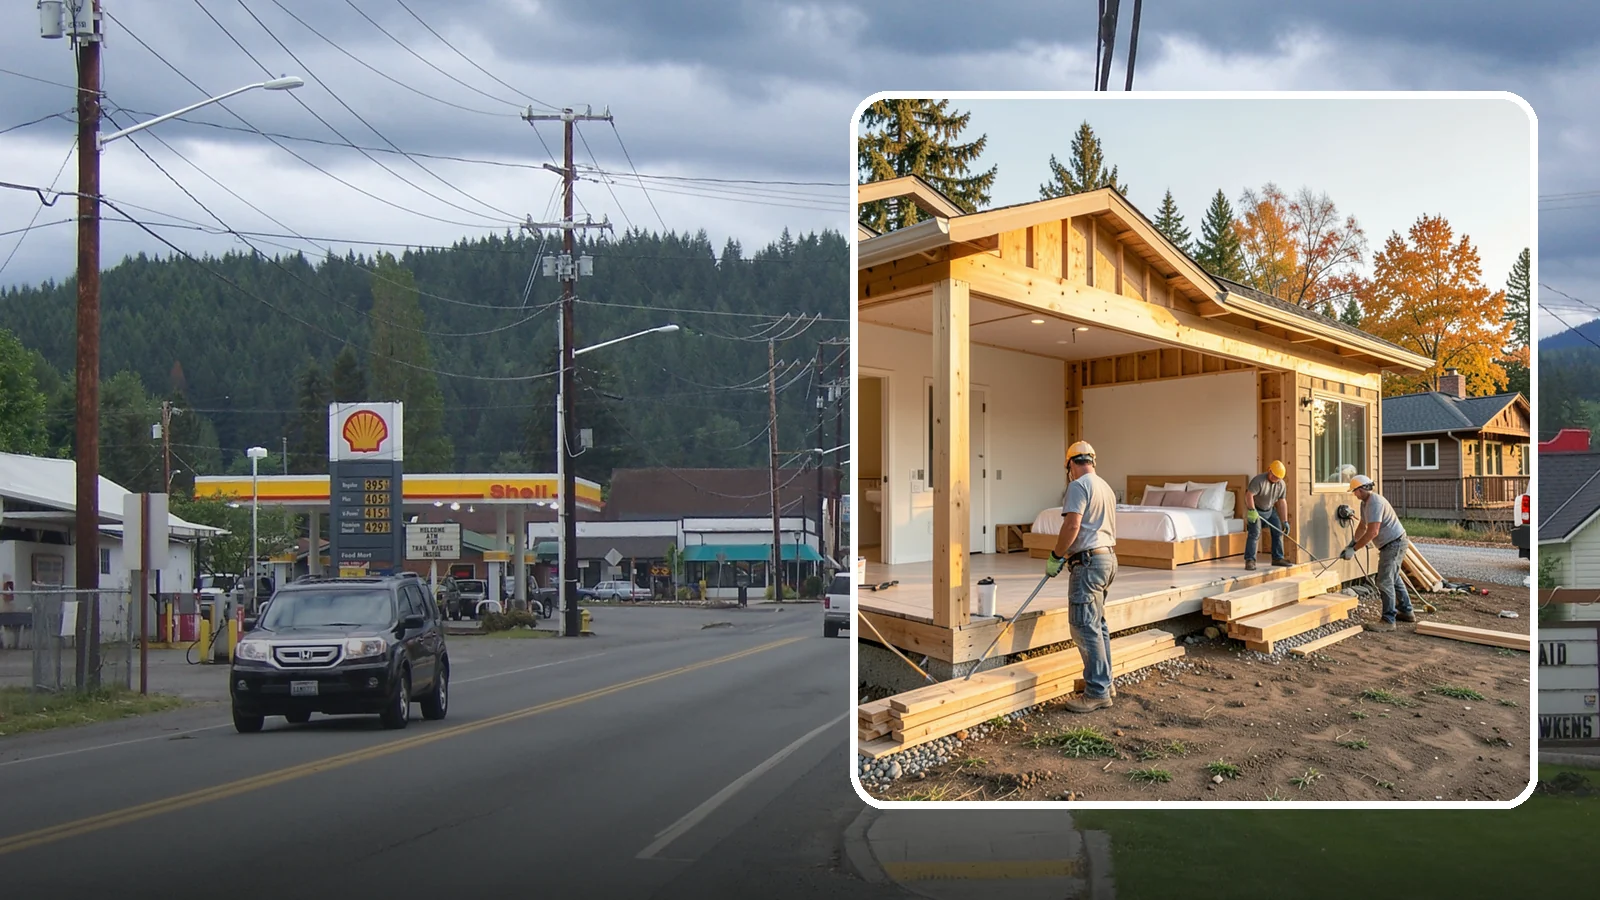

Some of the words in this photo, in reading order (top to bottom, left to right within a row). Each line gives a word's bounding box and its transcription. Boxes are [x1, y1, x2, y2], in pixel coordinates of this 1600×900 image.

[365, 480, 384, 490] 395
[490, 484, 548, 499] Shell
[365, 494, 384, 504] 405
[365, 508, 384, 518] 415
[365, 522, 384, 533] 429
